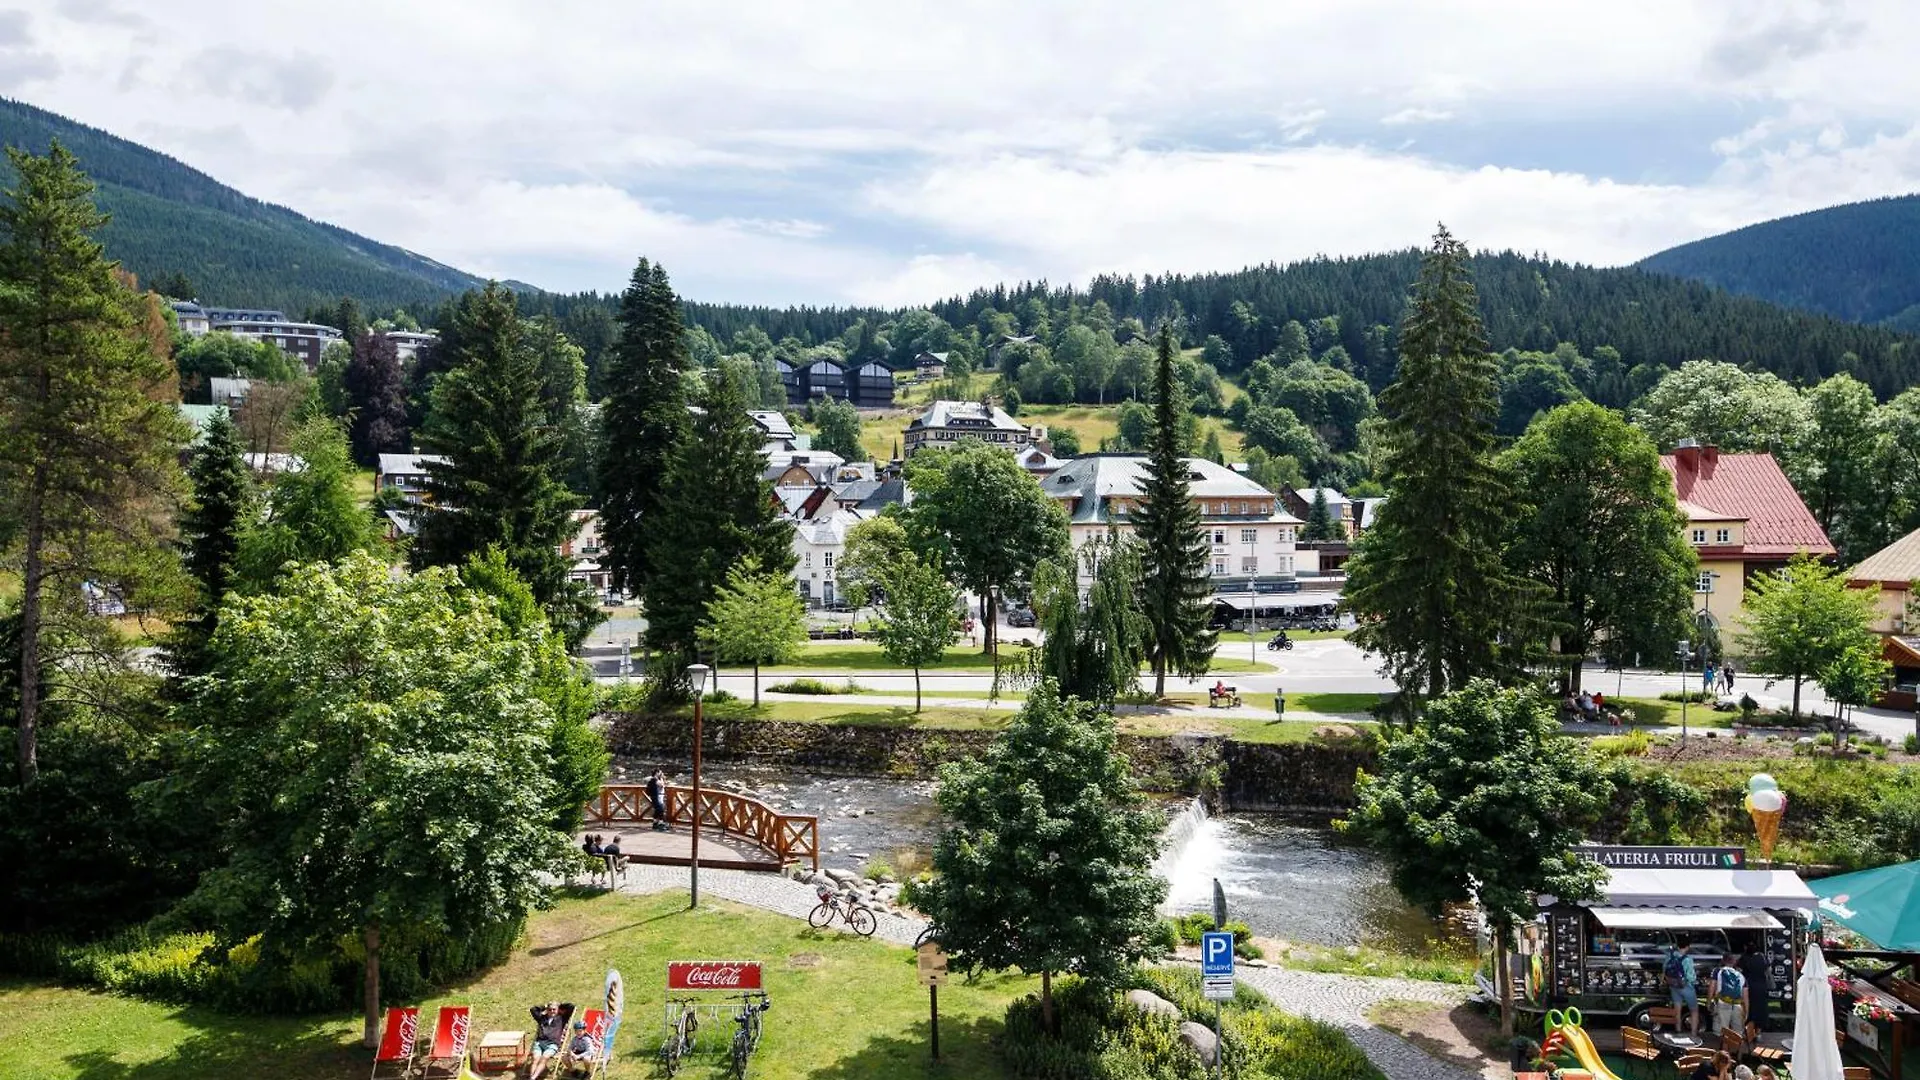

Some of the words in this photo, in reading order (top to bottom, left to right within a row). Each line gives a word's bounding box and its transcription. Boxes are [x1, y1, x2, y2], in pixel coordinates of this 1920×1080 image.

[1664, 852, 1717, 866] FRIULI
[1208, 937, 1227, 963] P
[686, 966, 743, 985] Coca-Cola
